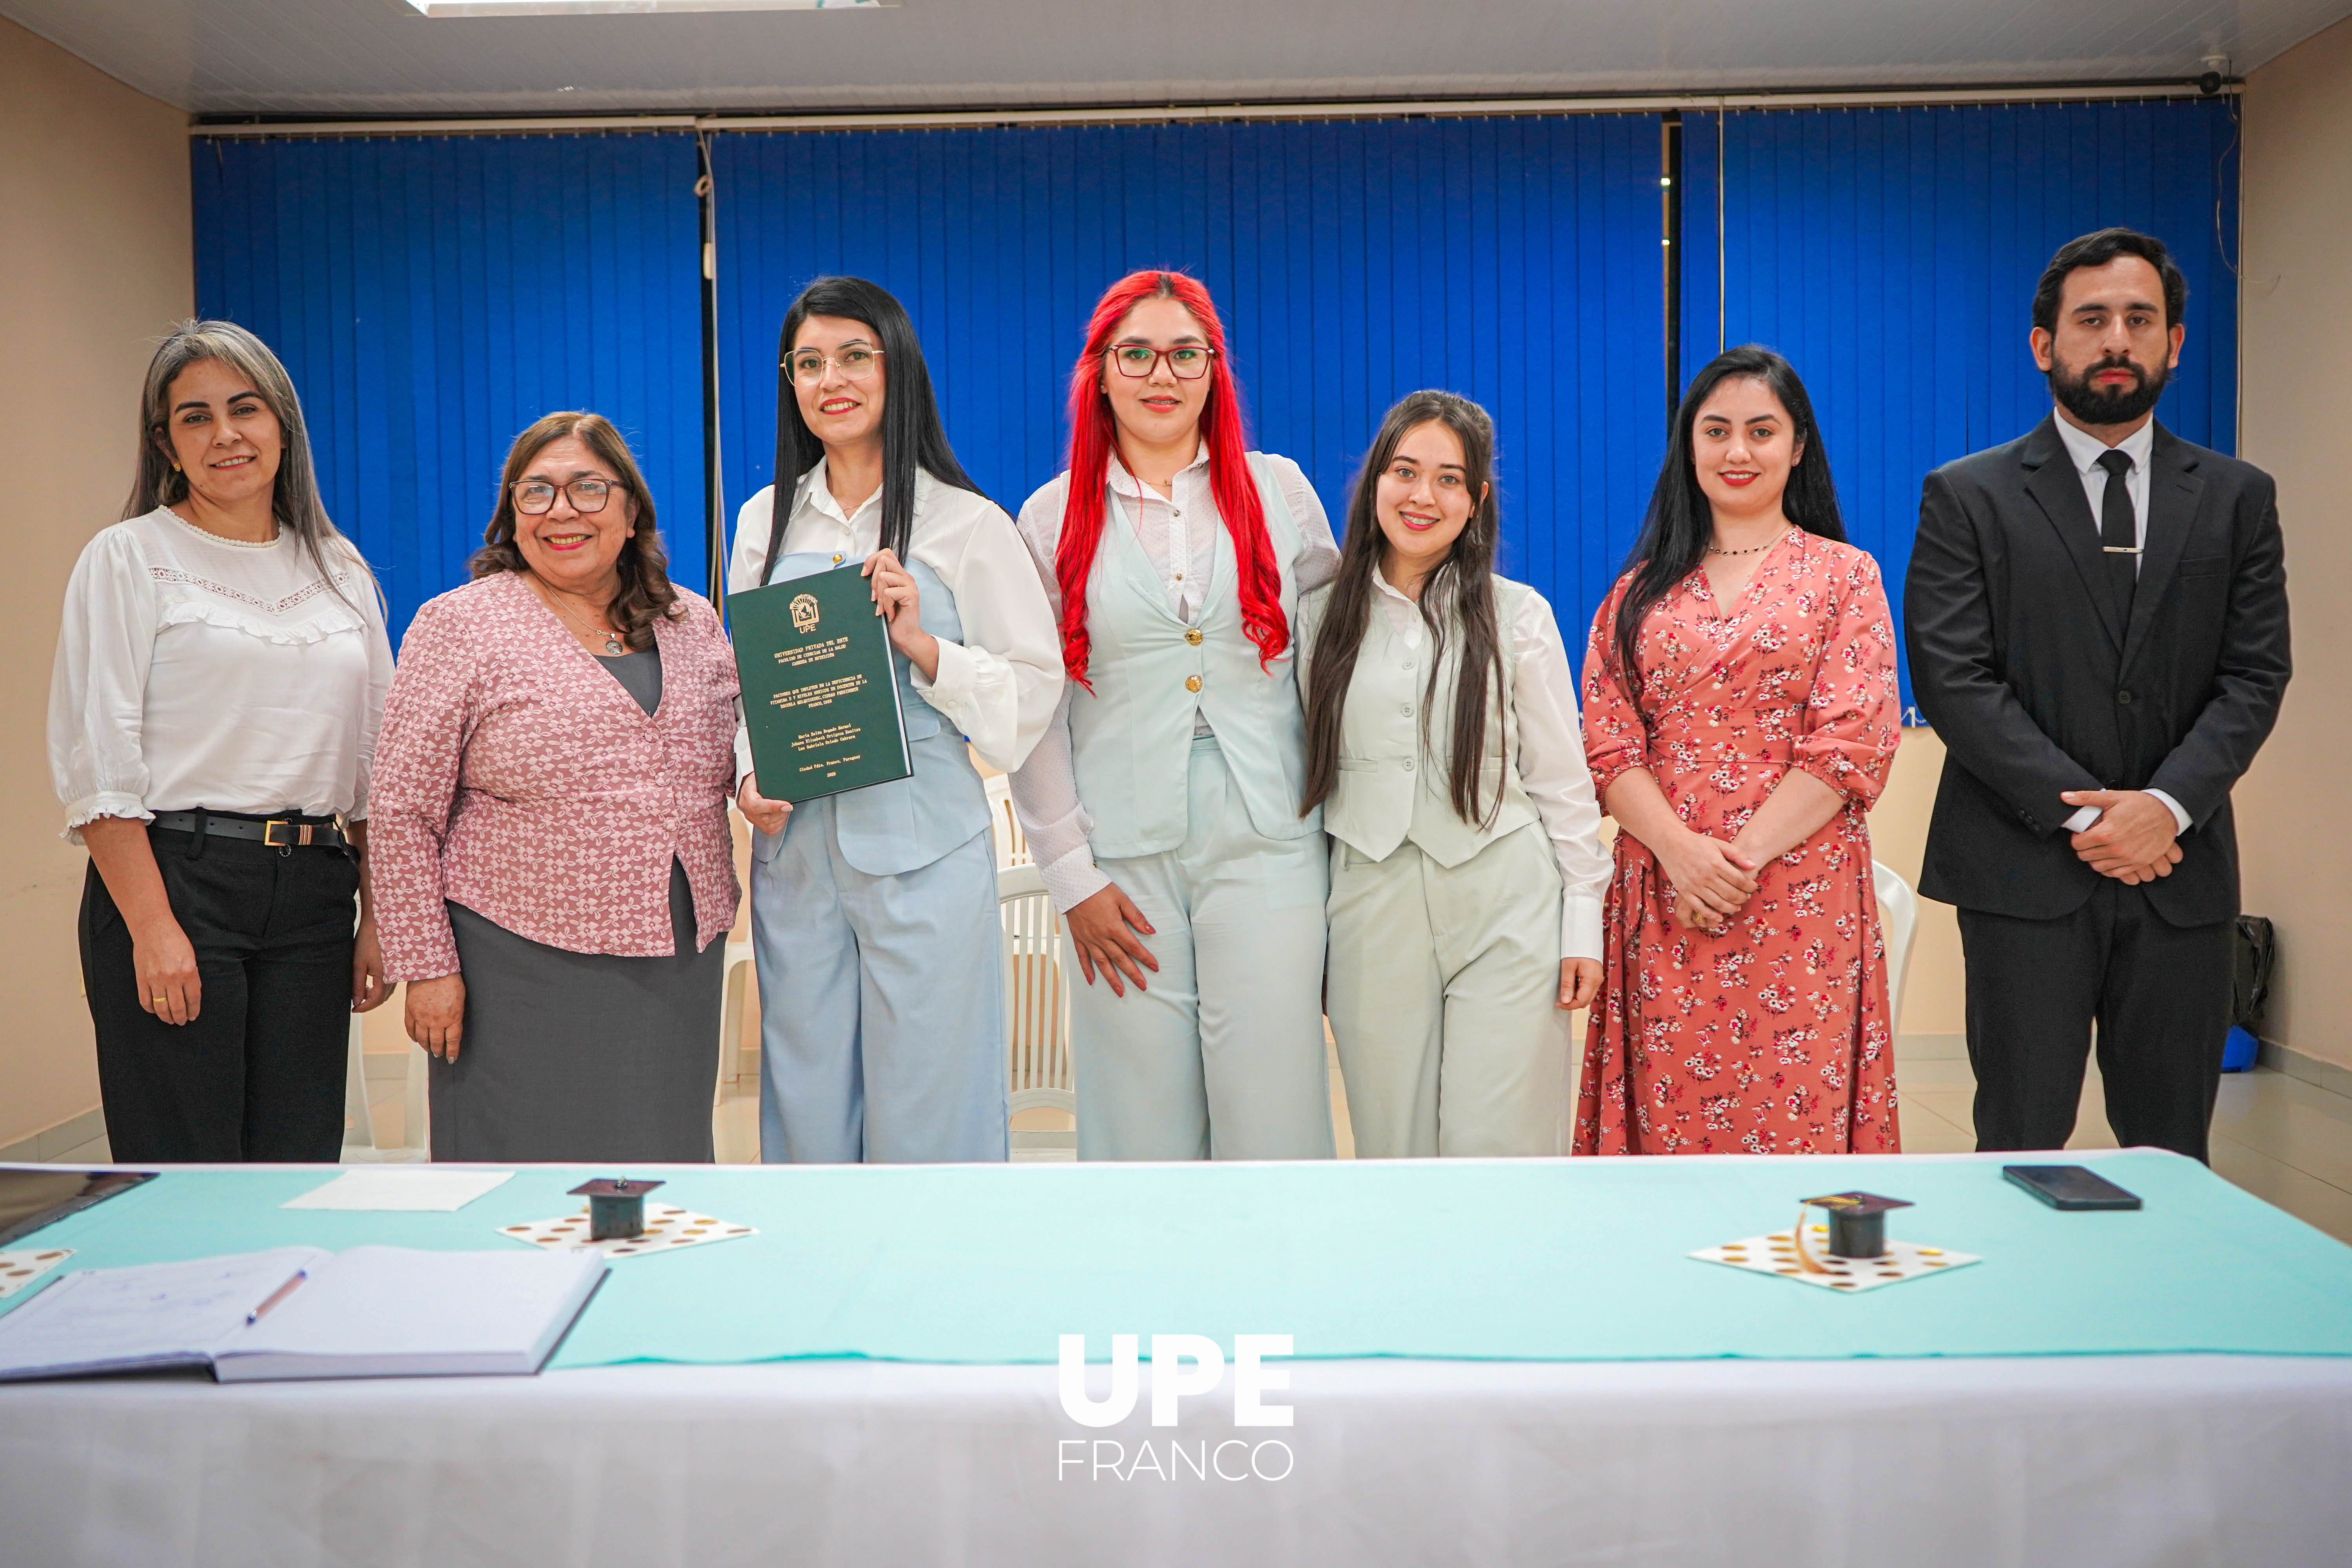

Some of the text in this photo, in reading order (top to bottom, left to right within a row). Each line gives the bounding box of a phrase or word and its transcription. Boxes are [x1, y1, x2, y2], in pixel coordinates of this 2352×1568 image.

[799, 624, 816, 633] UPE
[774, 647, 804, 658] UNIVERSIDAD
[805, 642, 825, 651] PRIVADA
[837, 686, 859, 695] PRESIDENTE
